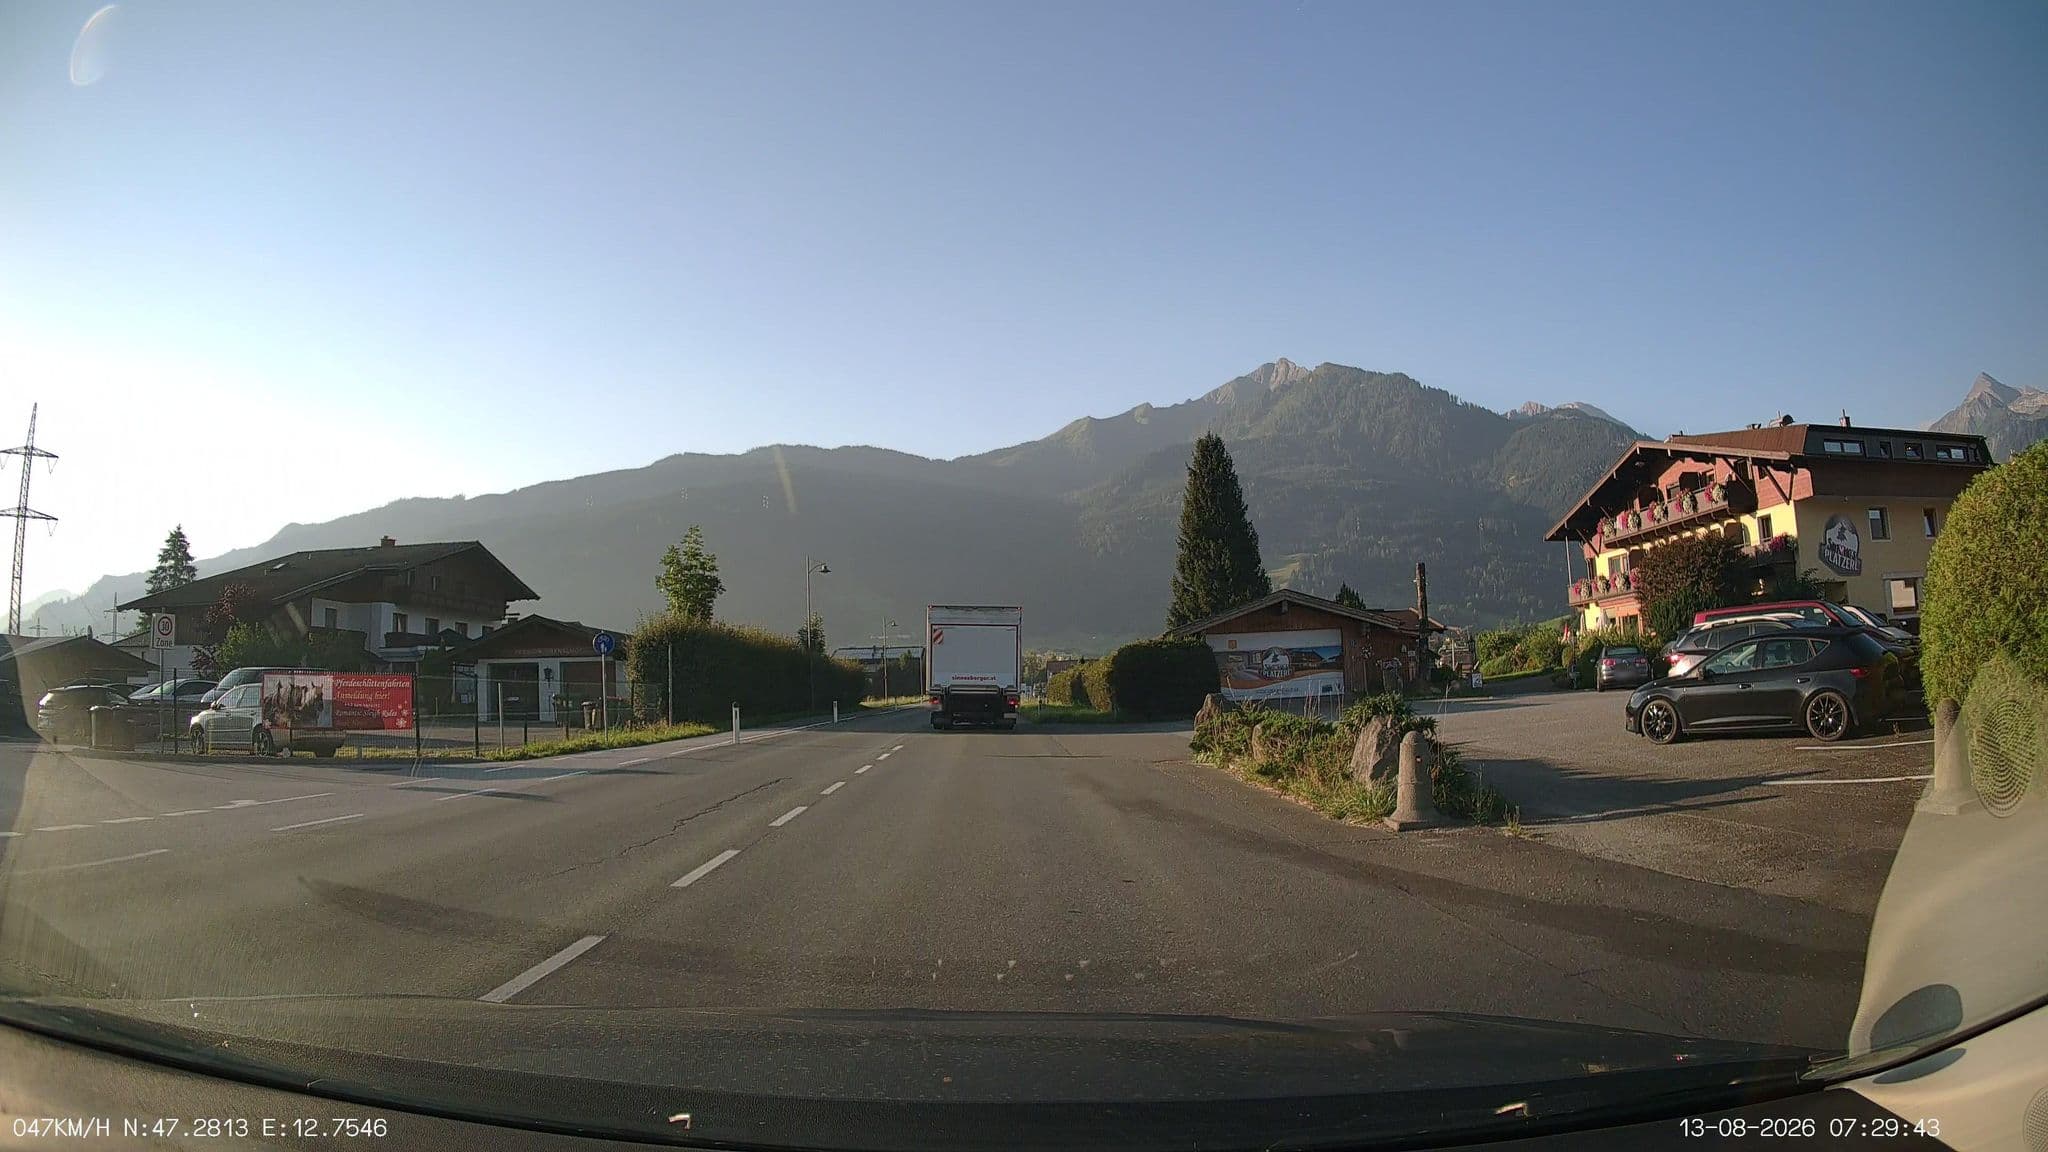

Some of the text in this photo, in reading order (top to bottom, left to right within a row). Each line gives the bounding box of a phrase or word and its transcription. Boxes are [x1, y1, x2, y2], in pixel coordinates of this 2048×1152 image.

[1825, 549, 1859, 570] PLATZERL
[161, 620, 170, 631] 30
[156, 638, 174, 647] Zone
[335, 678, 410, 690] Pferdeschlittenfahrten
[381, 709, 398, 717] Rides
